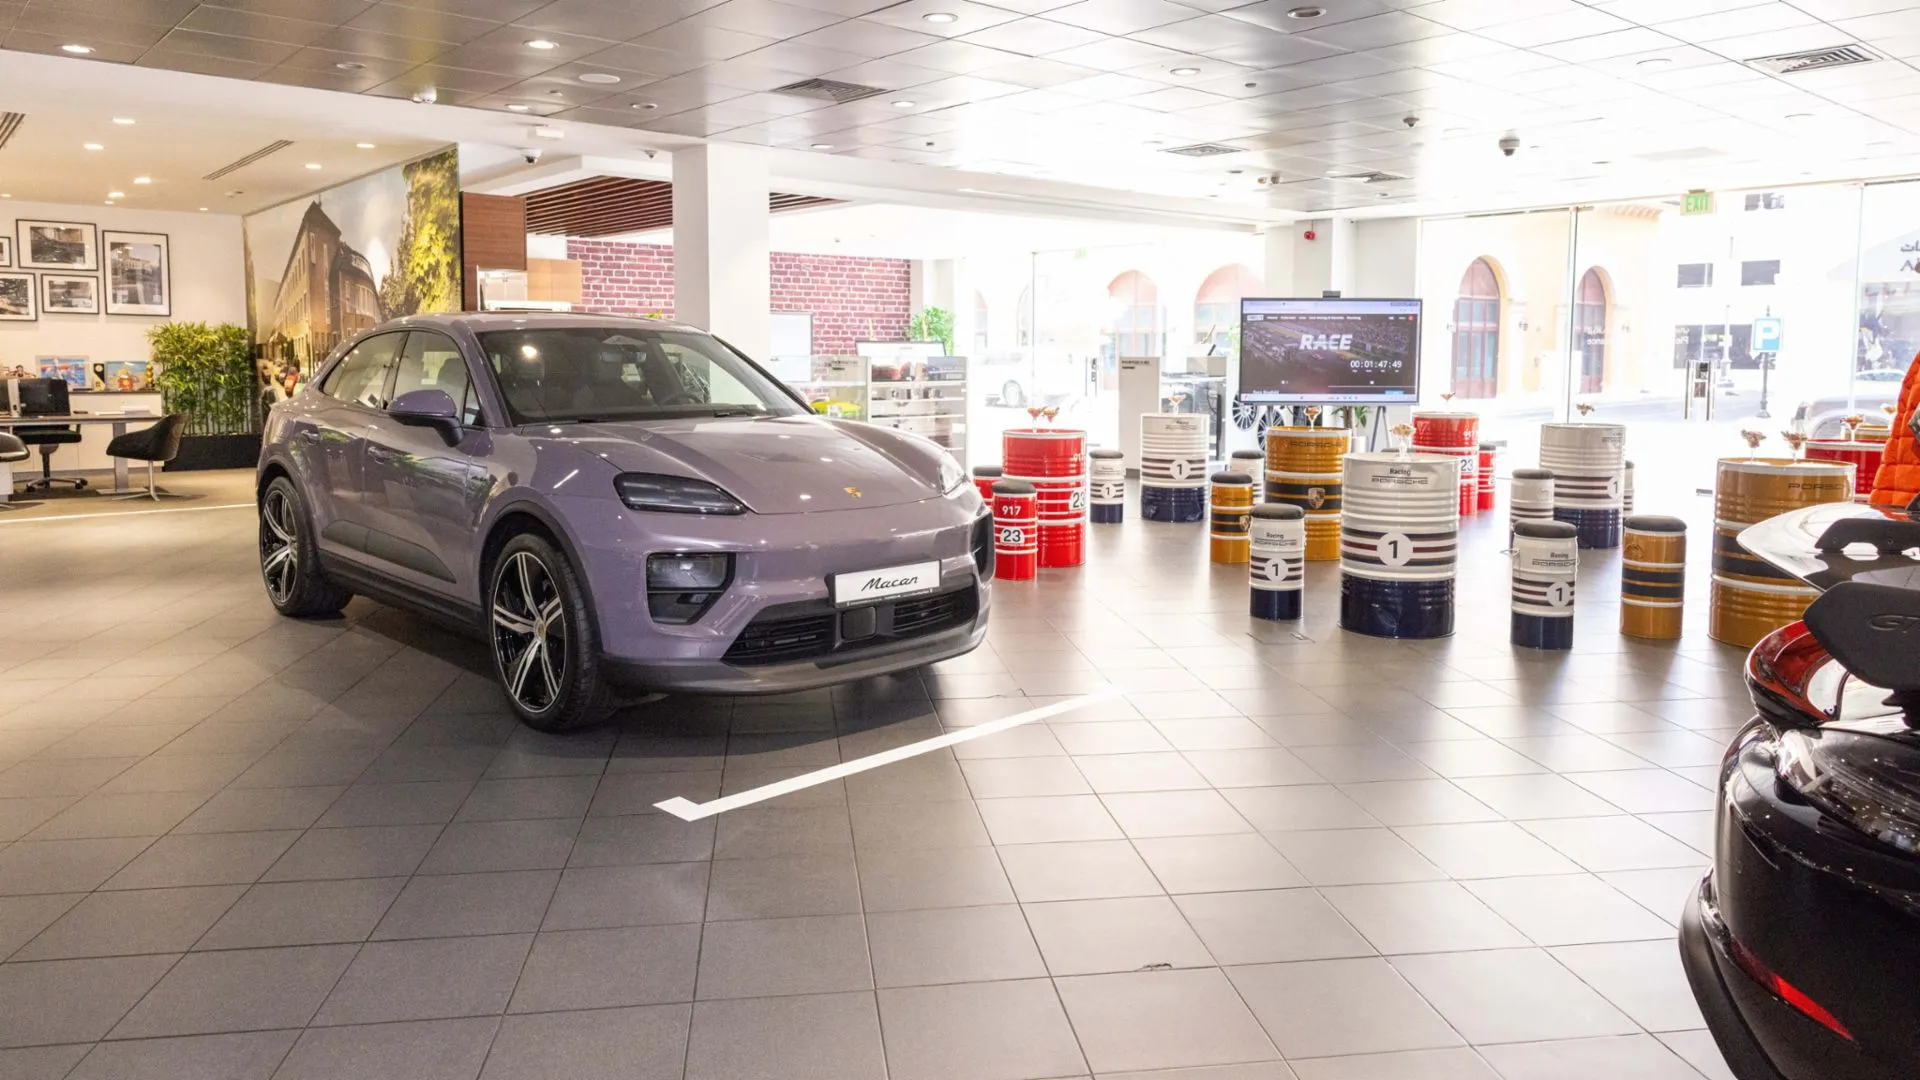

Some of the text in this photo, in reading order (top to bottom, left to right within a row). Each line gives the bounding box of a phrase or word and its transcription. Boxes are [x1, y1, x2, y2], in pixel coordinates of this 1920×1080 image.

[1685, 194, 1709, 213] EXIT
[1300, 333, 1353, 350] RACE
[1755, 319, 1780, 350] P
[1177, 463, 1183, 476] 1
[1389, 467, 1412, 477] Racing
[1105, 486, 1111, 496] 1
[1613, 481, 1619, 494] 1
[1002, 506, 1022, 516] 917
[1003, 529, 1021, 543] 23
[1388, 540, 1399, 559] 1
[1271, 563, 1279, 577] 1
[861, 576, 918, 592] Macan
[1555, 587, 1563, 602] 1
